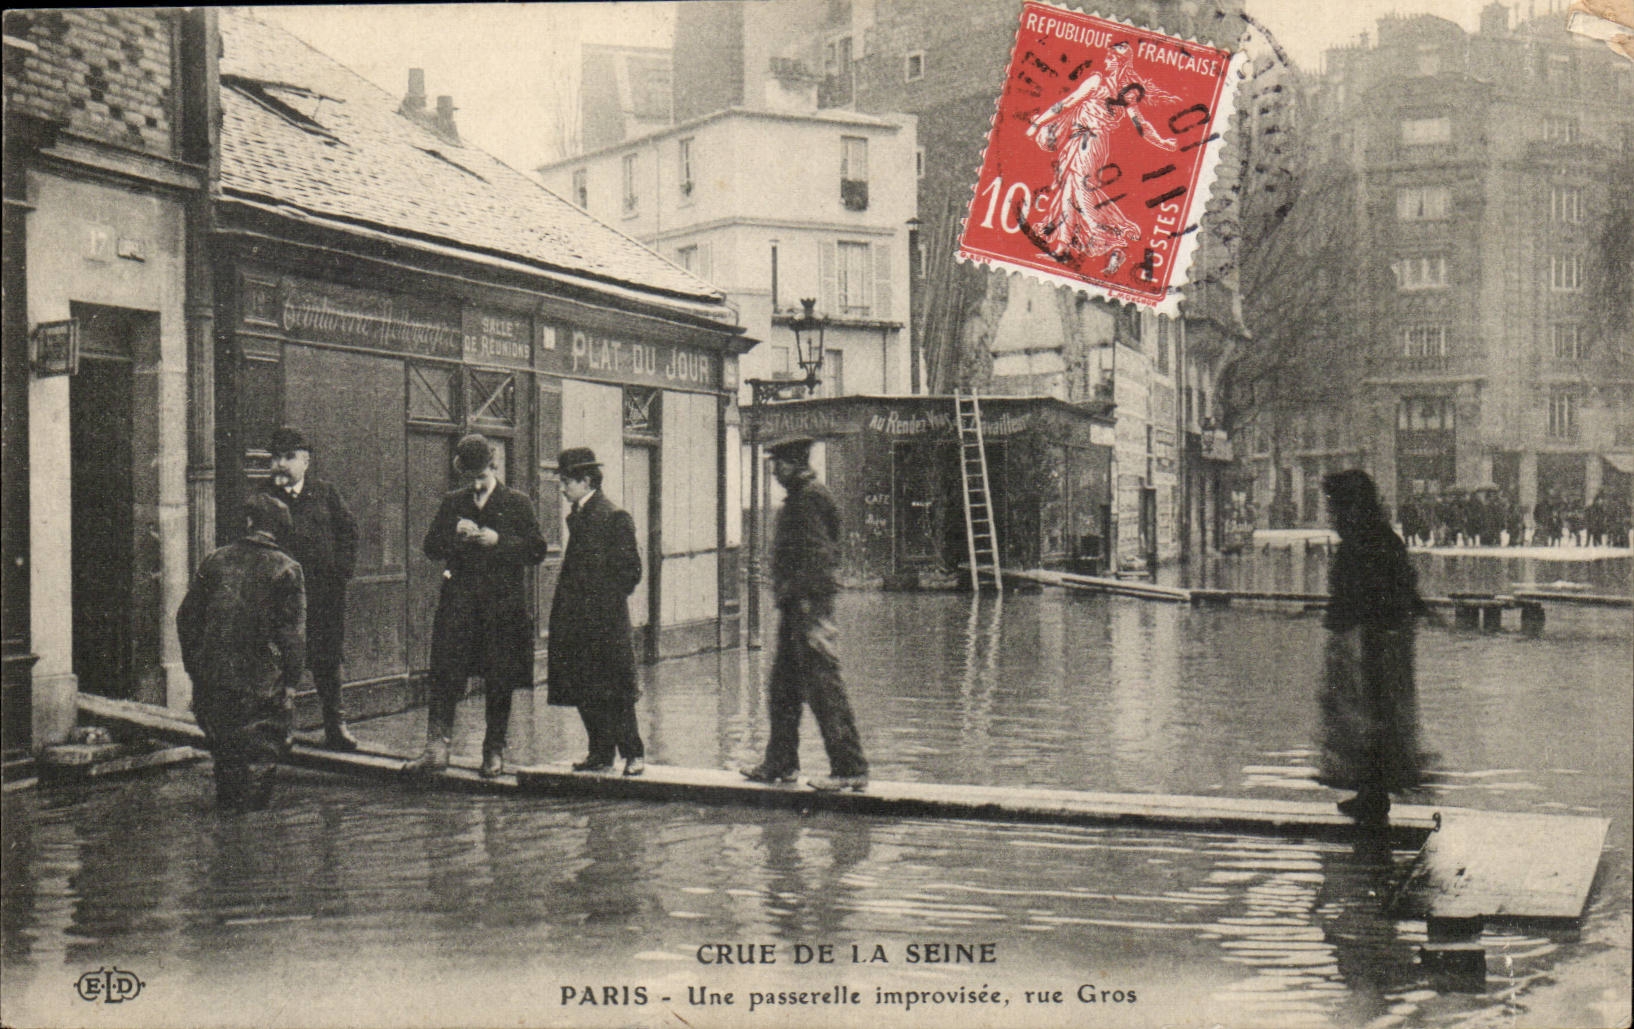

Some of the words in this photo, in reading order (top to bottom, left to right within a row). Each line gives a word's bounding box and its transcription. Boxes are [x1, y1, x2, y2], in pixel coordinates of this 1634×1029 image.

[1026, 12, 1113, 49] REPUBLIQUE
[1137, 41, 1219, 78] FRANÇAISE
[1140, 202, 1180, 284] POSTES
[464, 335, 477, 352] DE
[481, 317, 513, 337] SALLE
[572, 331, 622, 372] PLAT
[633, 344, 656, 376] DU
[665, 346, 710, 383] JOUR
